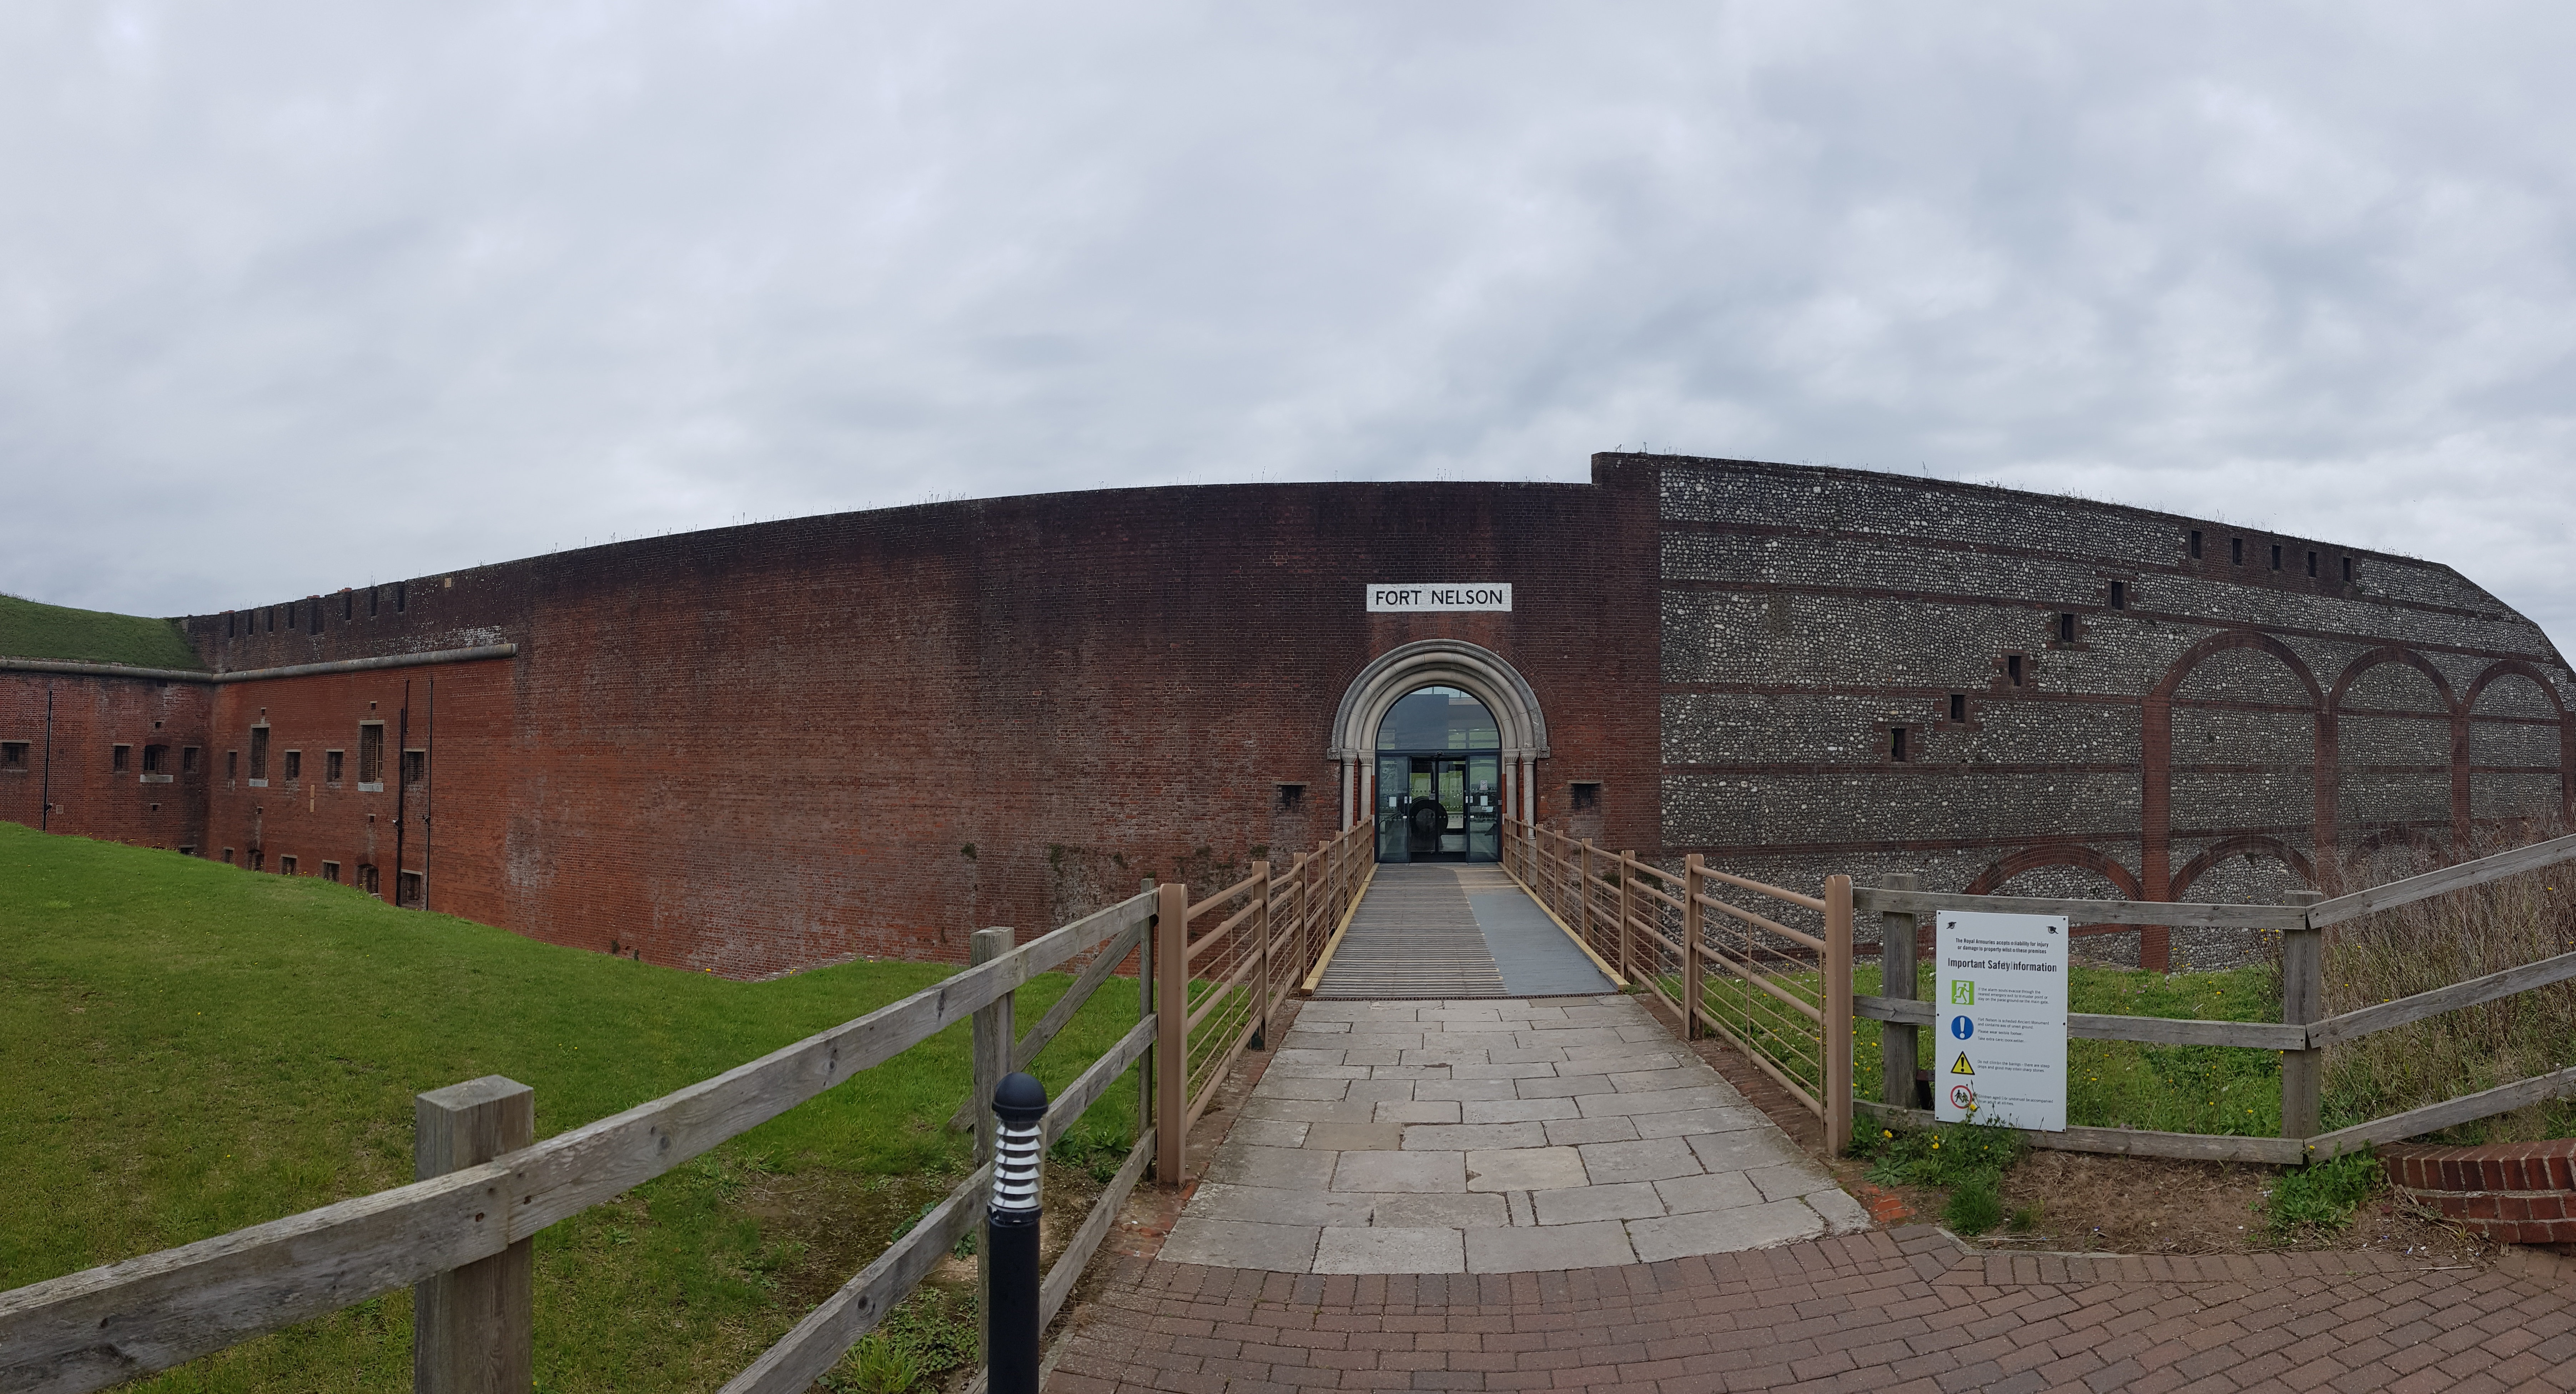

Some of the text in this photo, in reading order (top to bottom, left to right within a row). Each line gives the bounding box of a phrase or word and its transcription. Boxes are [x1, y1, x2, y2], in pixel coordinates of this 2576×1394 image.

[1376, 590, 1503, 605] FORT NELSON
[1948, 958, 1985, 969] Important
